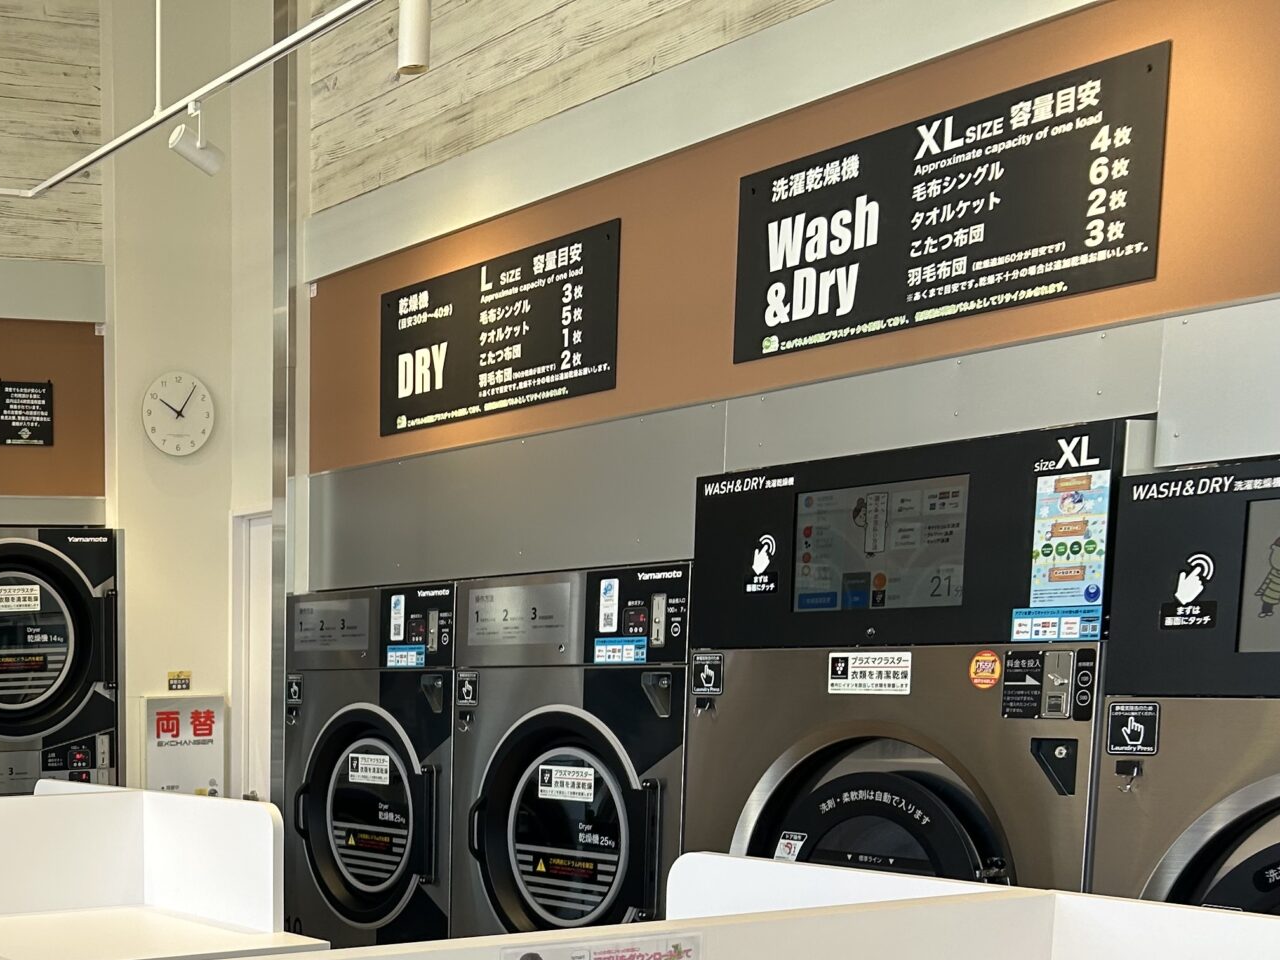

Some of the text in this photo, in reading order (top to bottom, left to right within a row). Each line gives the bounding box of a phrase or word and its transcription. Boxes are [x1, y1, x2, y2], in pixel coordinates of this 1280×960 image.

[914, 79, 1102, 161] XL SIZE 容量目安
[914, 111, 1102, 177] Approximate capacity of one load
[772, 154, 859, 203] 洗濯乾燥機
[912, 161, 1004, 202] 毛布シングル
[910, 192, 1001, 232] タオルケット
[768, 194, 880, 273] Wash
[910, 224, 985, 259] こたつ布団
[481, 243, 582, 291] L SIZE 容量目安
[907, 257, 966, 287] 羽毛布団
[481, 266, 583, 303] Approximate capacity of one load
[765, 262, 859, 327] &Dry
[399, 291, 428, 315] 乾燥機
[480, 299, 530, 325] 毛布シングル
[480, 321, 529, 346] タオルケット
[479, 344, 521, 366] こたつ布団
[398, 342, 448, 399] DRY
[479, 367, 512, 388] 羽毛布団
[1034, 435, 1100, 472] size XL
[638, 570, 682, 580] Yamamoto
[417, 589, 450, 597] Yamamoto
[475, 611, 479, 623] 1
[1165, 616, 1211, 626] 画面にタッチ
[1177, 606, 1200, 615] まずは
[851, 671, 908, 680] 衣類を清潔乾燥
[852, 657, 909, 665] プラズマクラスター
[156, 710, 215, 738] 両替
